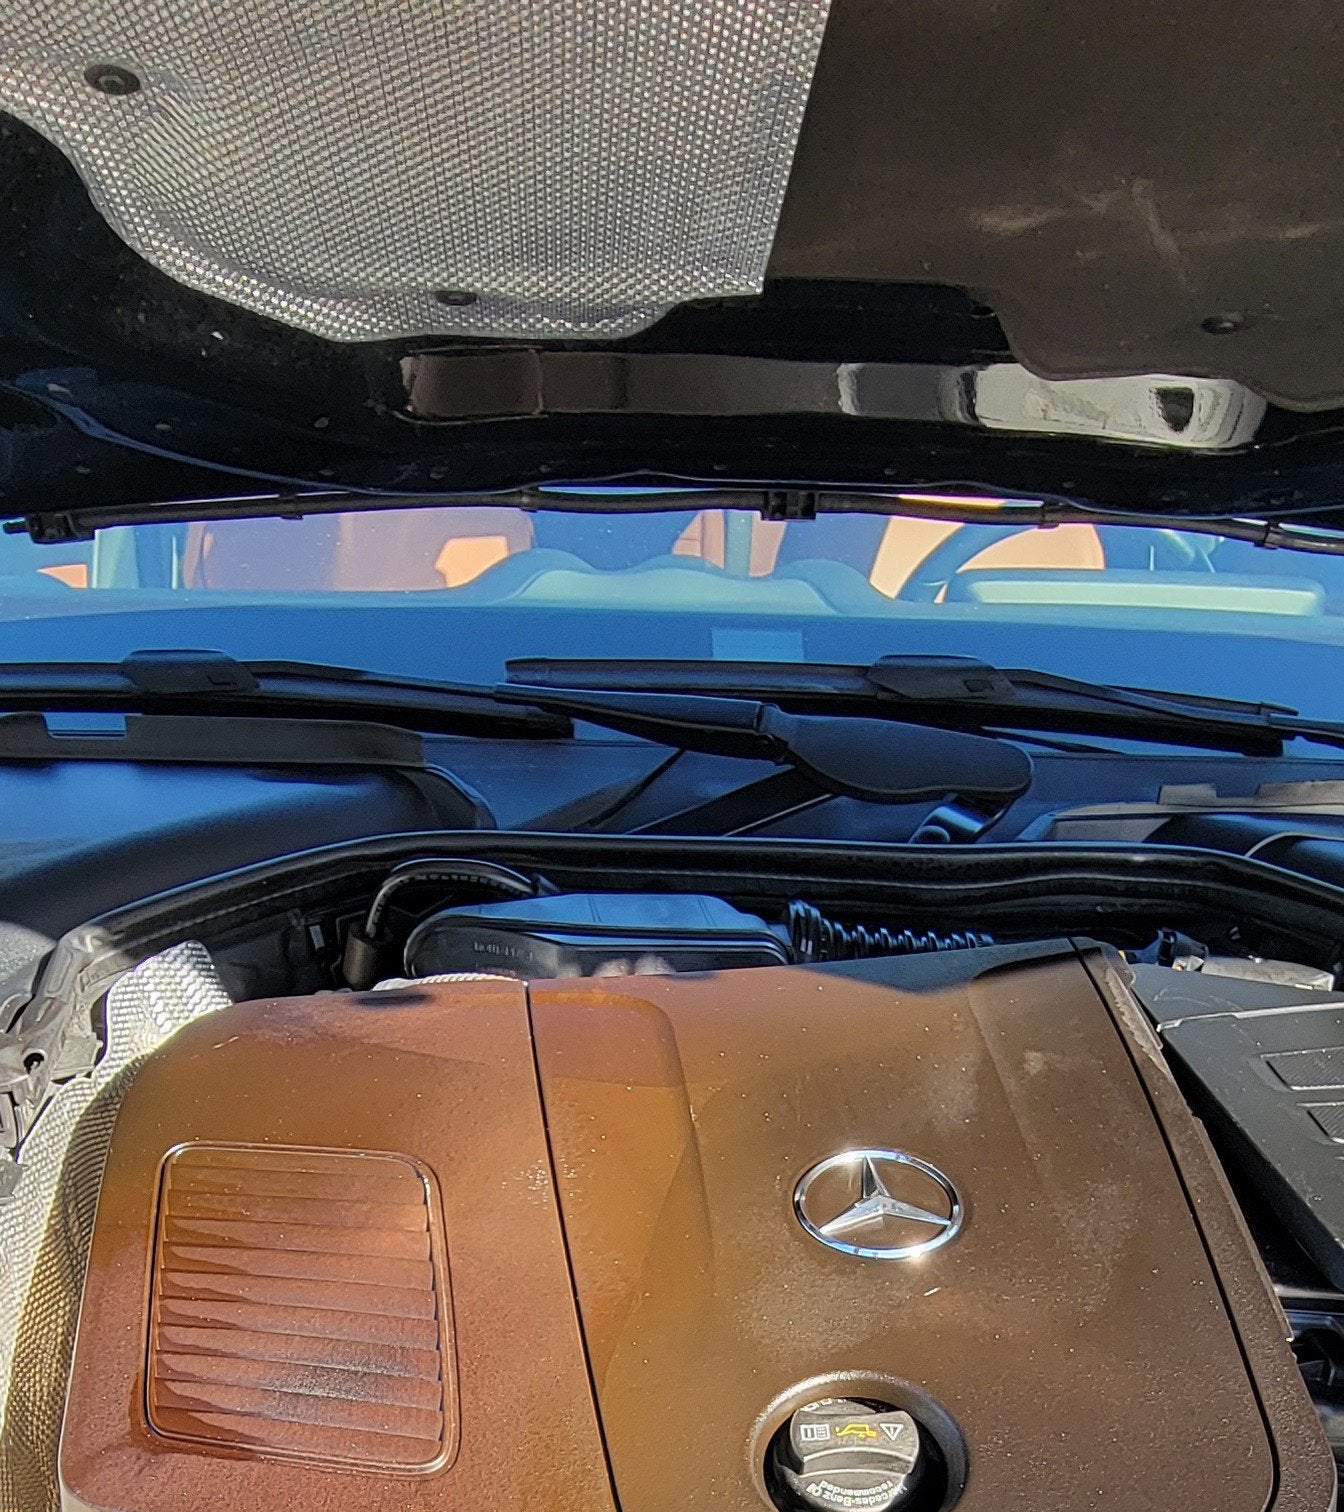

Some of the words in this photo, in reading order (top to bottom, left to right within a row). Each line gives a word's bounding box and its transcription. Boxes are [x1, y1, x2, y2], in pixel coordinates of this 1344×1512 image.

[806, 1482, 823, 1498] Oil
[821, 1480, 893, 1497] recommended
[822, 1482, 908, 1507] Mercedes-Benz
